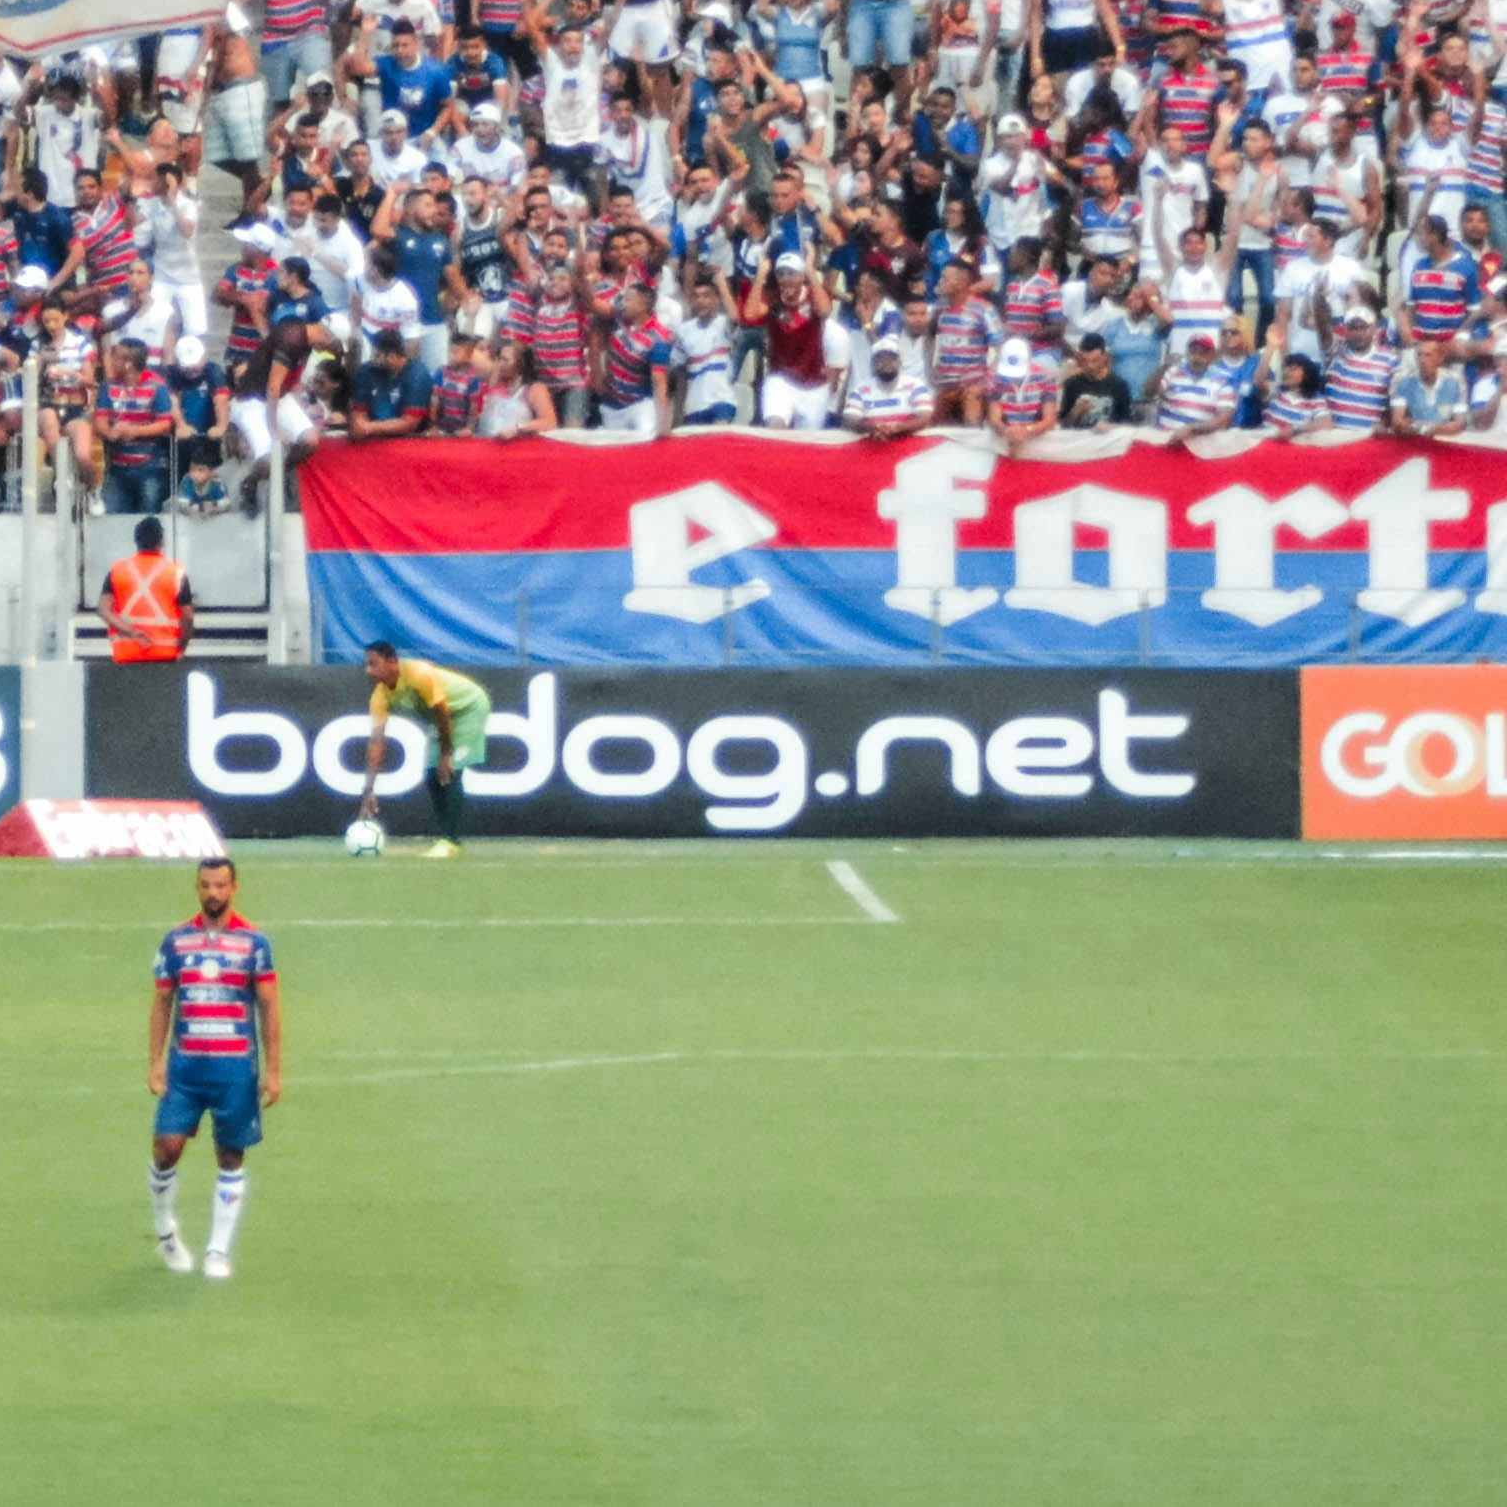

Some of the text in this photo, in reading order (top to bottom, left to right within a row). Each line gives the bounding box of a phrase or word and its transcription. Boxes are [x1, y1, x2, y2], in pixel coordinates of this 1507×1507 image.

[623, 438, 1507, 628] e fort
[187, 670, 1195, 830] bodog.net
